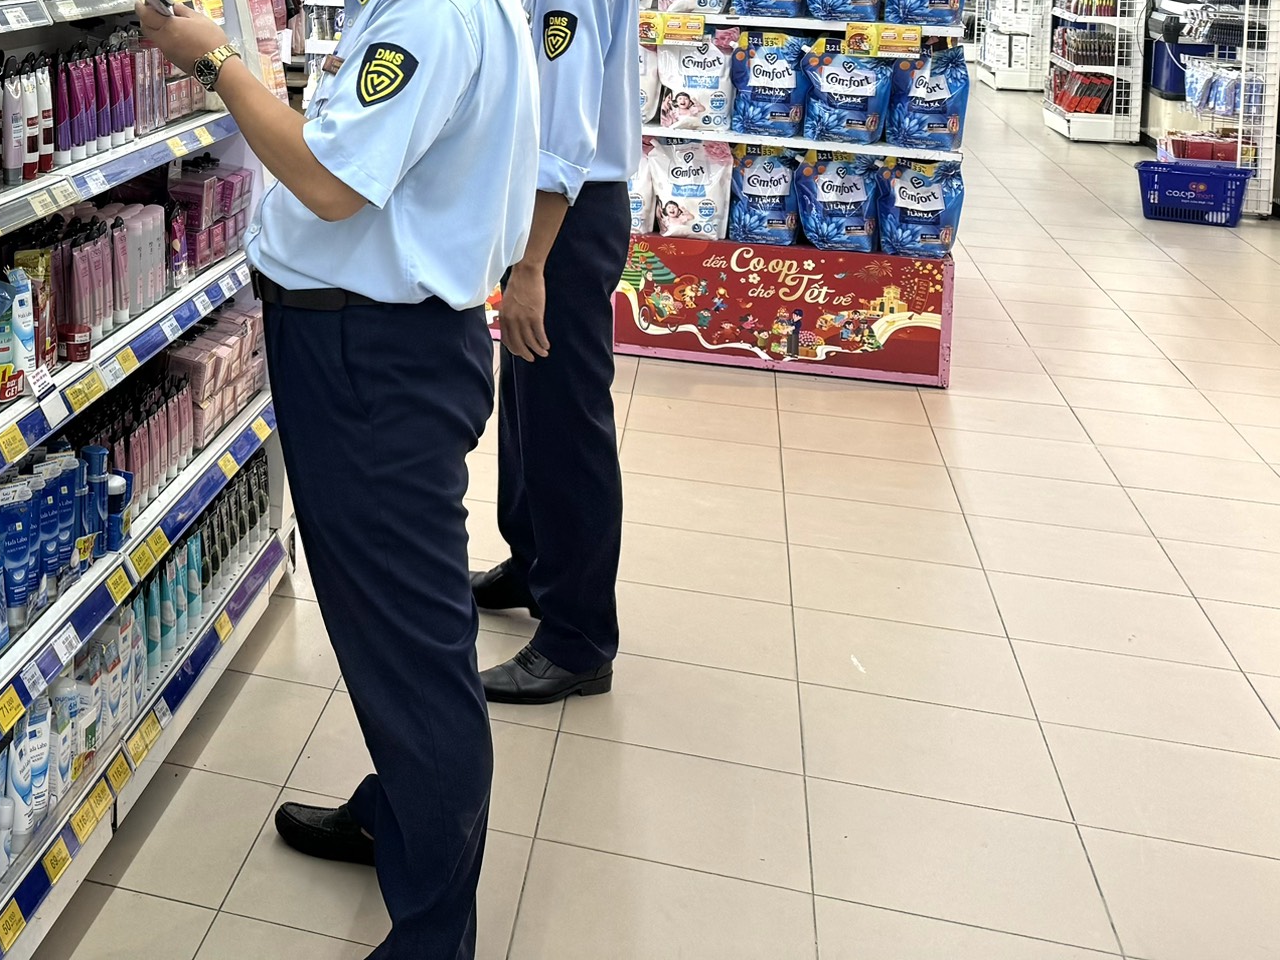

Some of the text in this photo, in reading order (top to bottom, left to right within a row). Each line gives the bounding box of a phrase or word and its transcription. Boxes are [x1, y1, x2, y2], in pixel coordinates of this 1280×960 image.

[549, 16, 568, 27] DMS
[375, 48, 405, 65] DMS
[682, 56, 723, 71] Comfort
[753, 64, 793, 81] Comfort
[671, 165, 705, 179] Comfort
[747, 174, 789, 189] Comfort
[821, 180, 861, 195] Comfort
[898, 187, 940, 205] Comfort
[730, 246, 800, 283] Co.op
[778, 273, 836, 304] Tết
[833, 292, 856, 306] về
